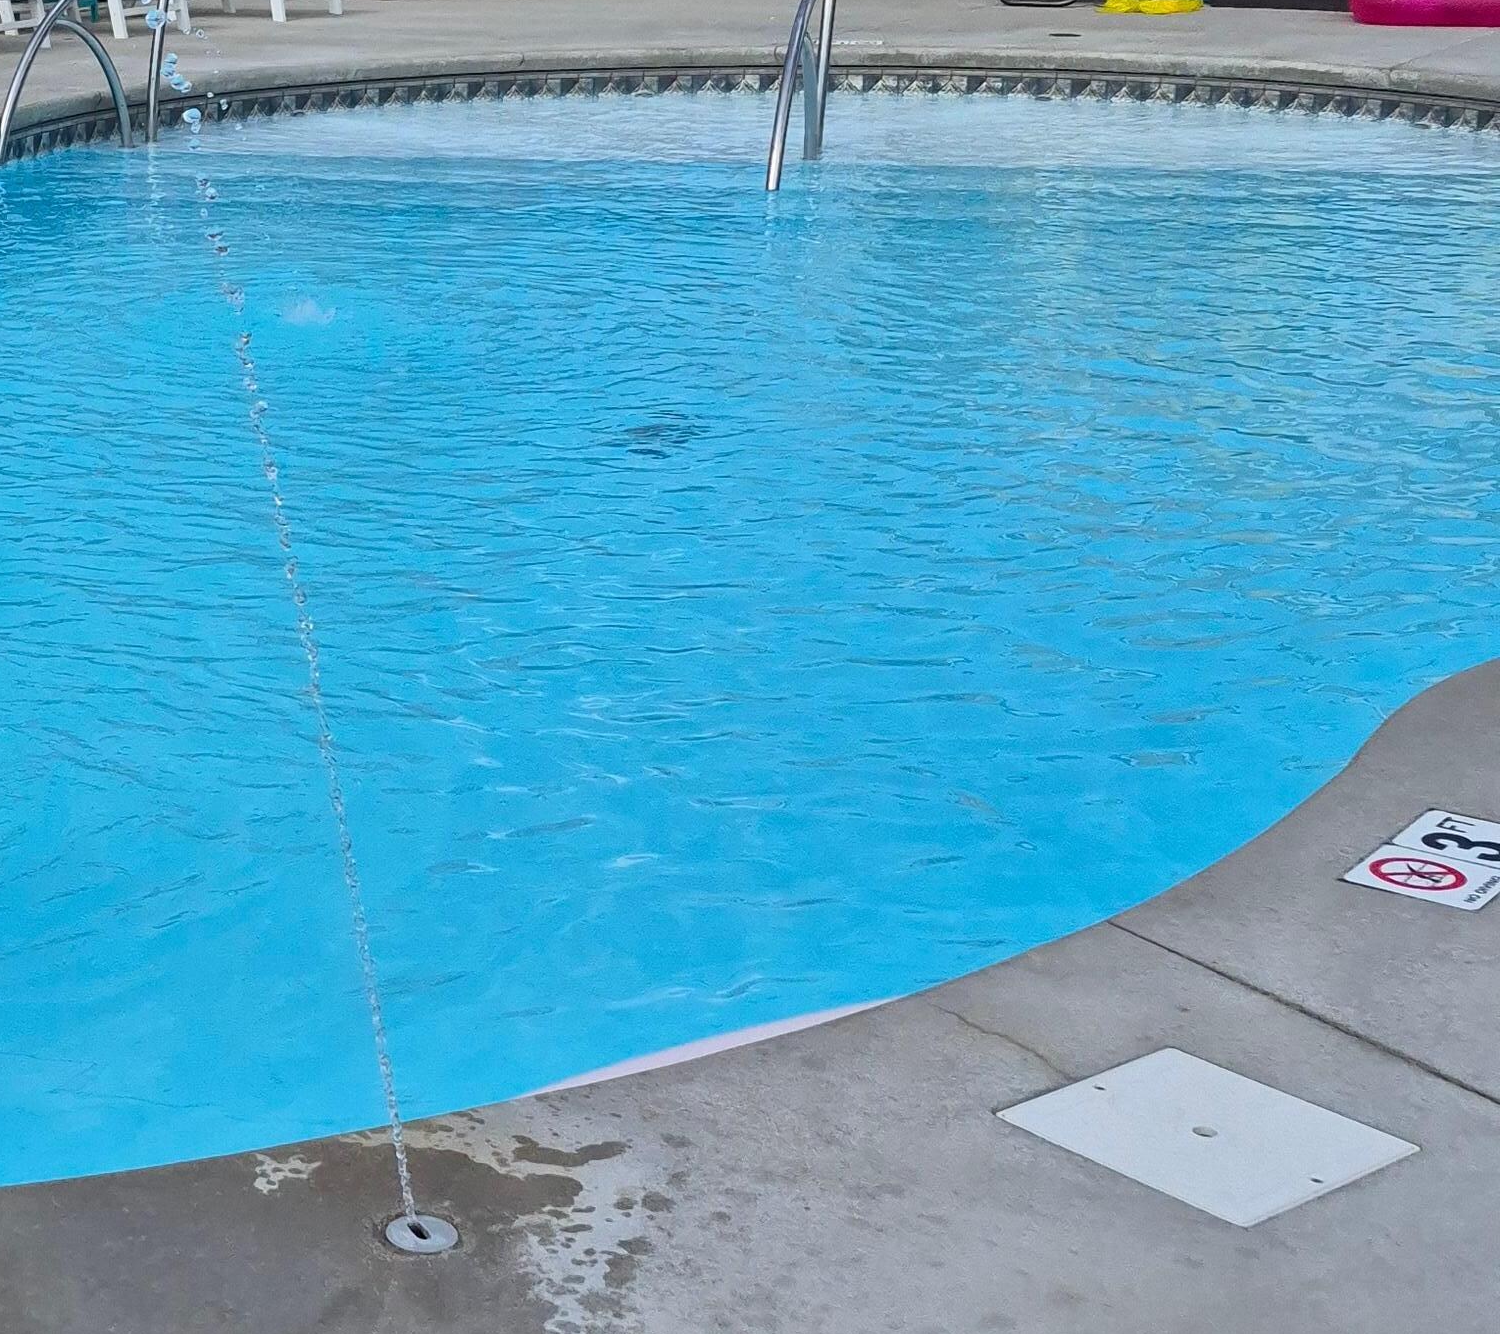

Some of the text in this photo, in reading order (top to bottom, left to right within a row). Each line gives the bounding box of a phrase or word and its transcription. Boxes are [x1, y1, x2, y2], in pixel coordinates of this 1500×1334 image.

[1436, 817, 1476, 833] FT
[1421, 832, 1500, 862] 3
[1463, 893, 1481, 904] NO
